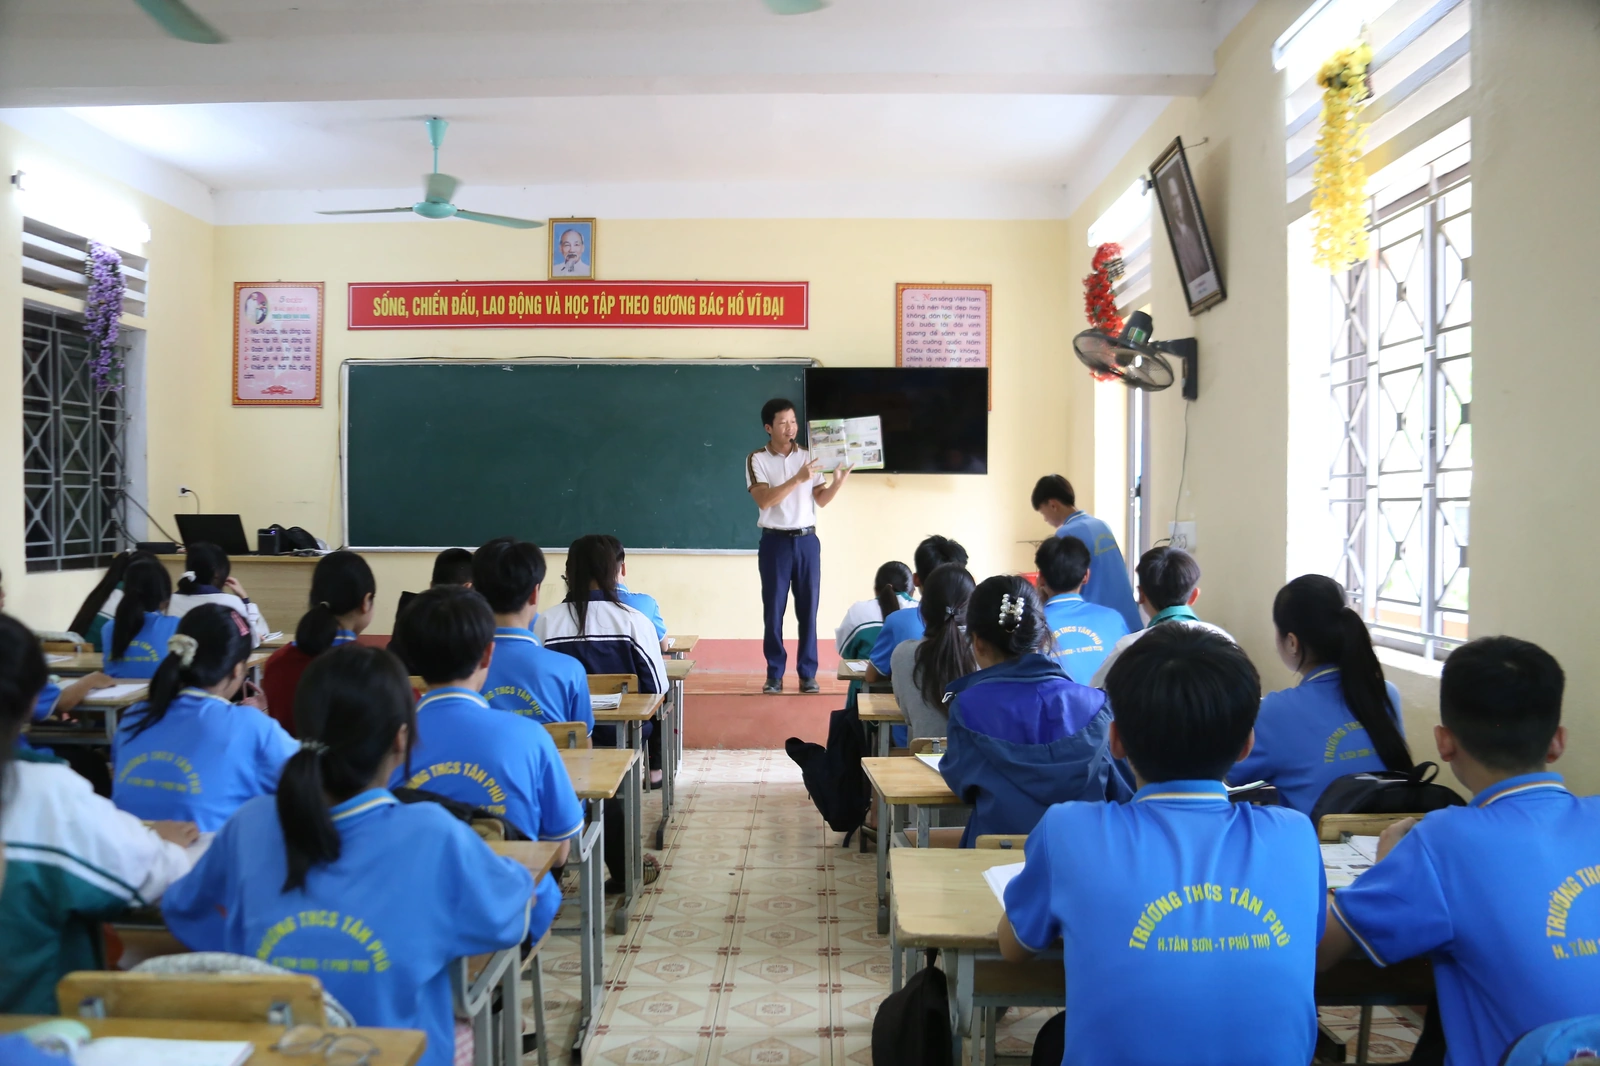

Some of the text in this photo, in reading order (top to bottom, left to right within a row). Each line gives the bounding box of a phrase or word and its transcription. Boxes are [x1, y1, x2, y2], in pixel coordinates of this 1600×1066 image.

[373, 290, 784, 320] SỐNG, CHIẾN ĐẤU, LAO ĐỘNG VÀ HỌC TẬP THEO GƯƠNG BÁC HỒ VĨ ĐẠI
[1129, 882, 1290, 949] TRƯỜNG THCS TÂN PHÚ
[1545, 876, 1583, 938] TRƯỜNG
[1228, 933, 1249, 950] PHÚ
[1251, 933, 1270, 950] THỌ
